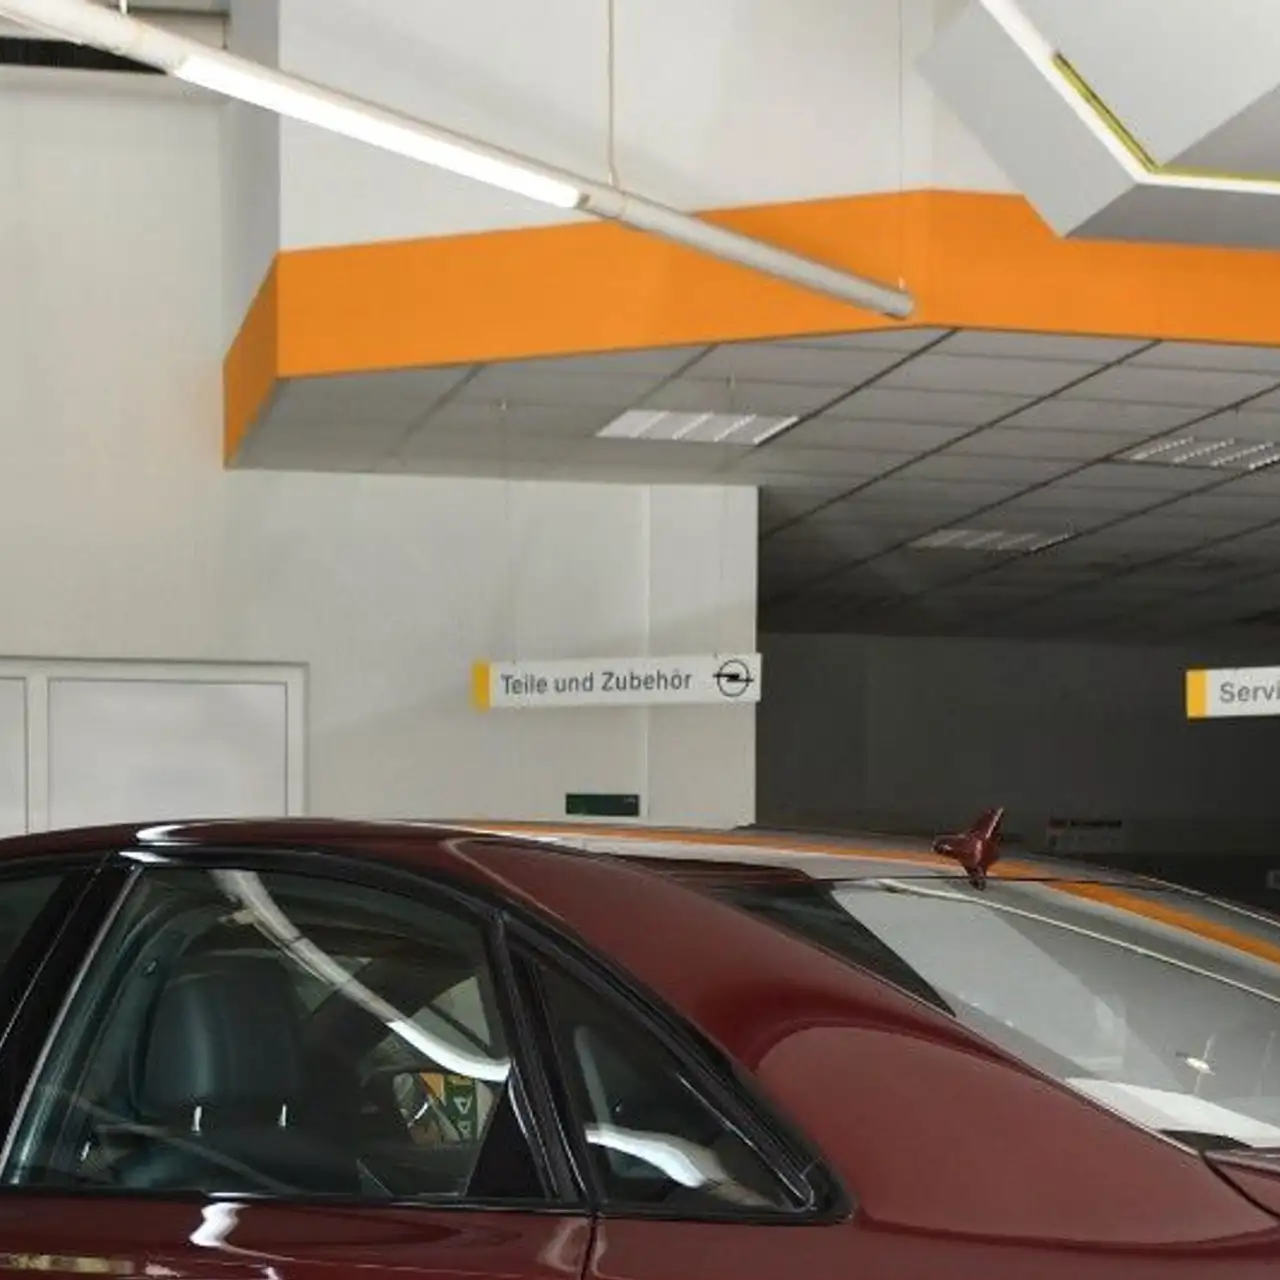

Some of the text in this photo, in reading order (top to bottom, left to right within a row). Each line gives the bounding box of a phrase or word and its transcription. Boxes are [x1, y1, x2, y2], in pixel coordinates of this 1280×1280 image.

[501, 670, 694, 695] Teile und Zubehör
